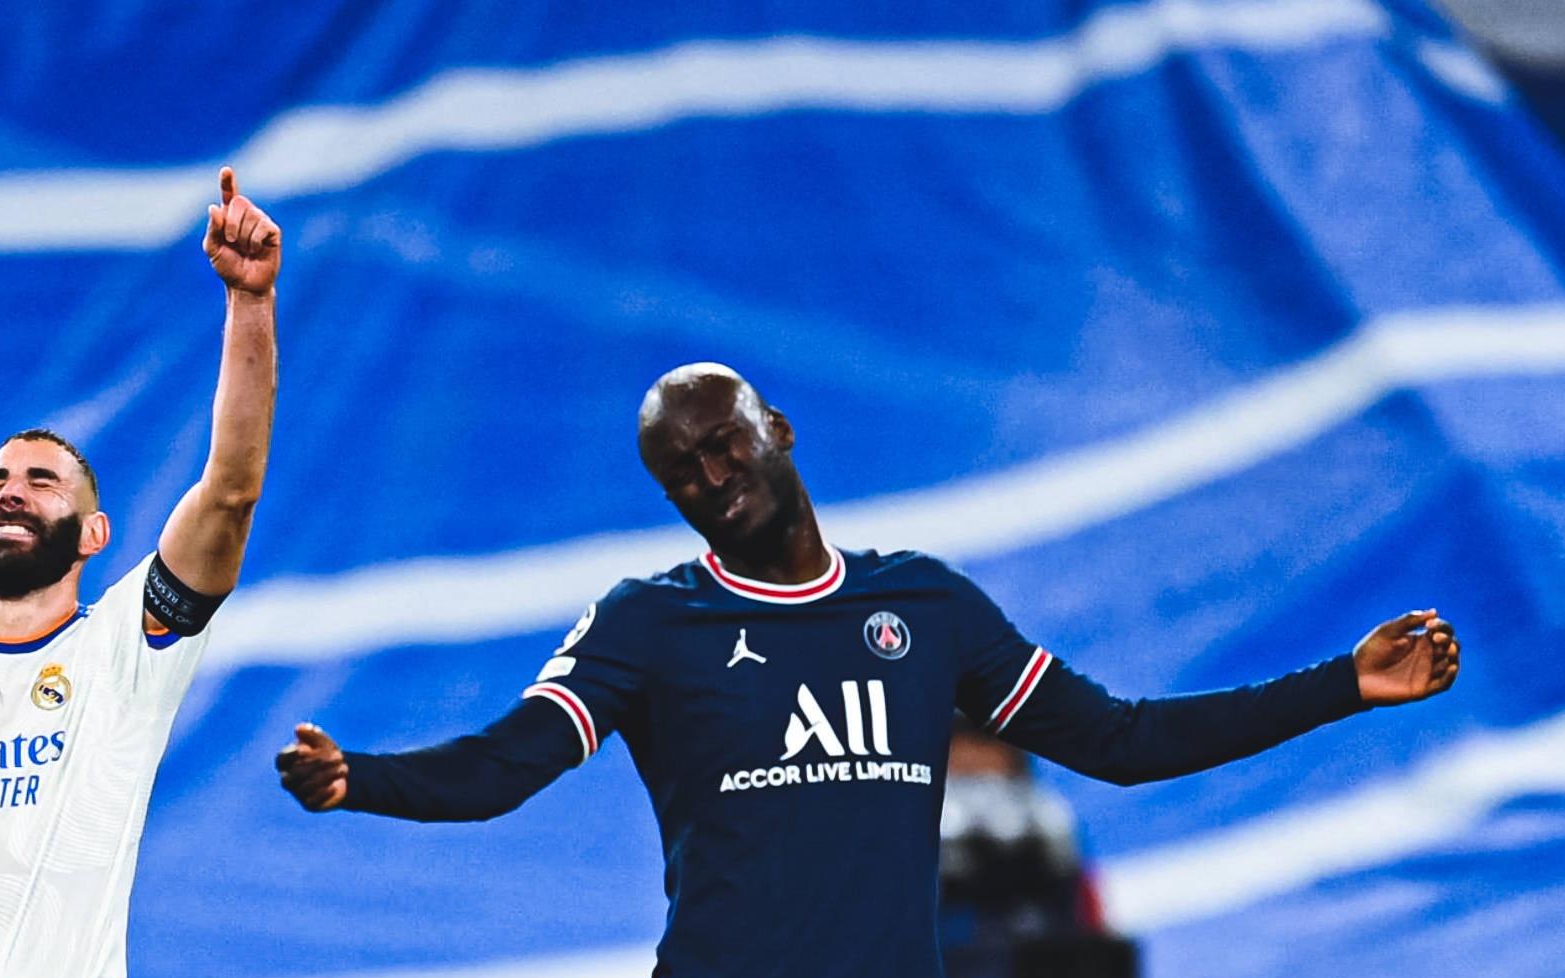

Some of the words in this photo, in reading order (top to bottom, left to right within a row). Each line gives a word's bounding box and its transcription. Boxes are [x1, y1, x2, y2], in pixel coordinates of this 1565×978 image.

[719, 764, 802, 793] ACCOR
[805, 761, 853, 784] LIVE
[855, 760, 932, 785] LIMITLESS
